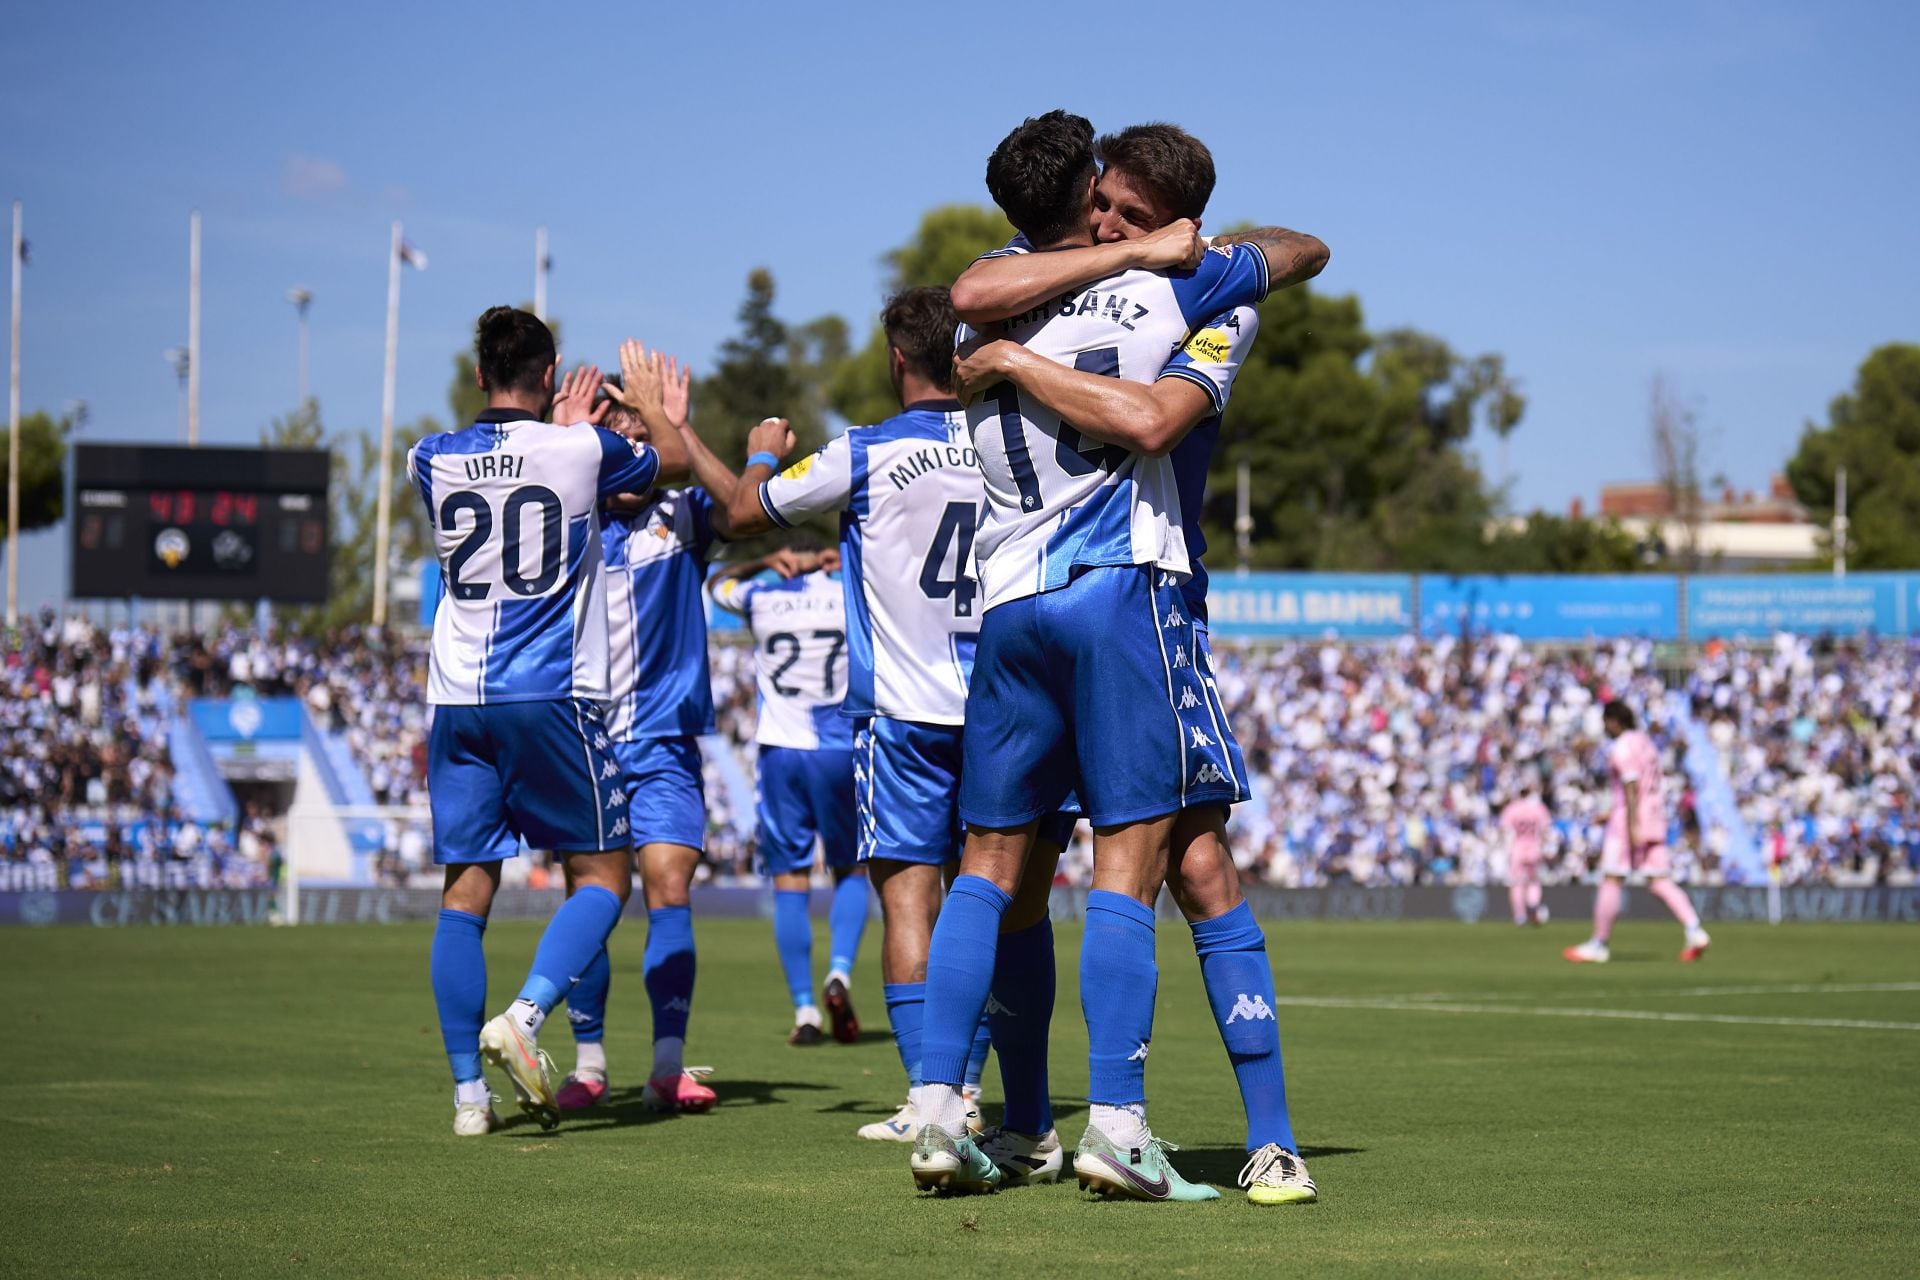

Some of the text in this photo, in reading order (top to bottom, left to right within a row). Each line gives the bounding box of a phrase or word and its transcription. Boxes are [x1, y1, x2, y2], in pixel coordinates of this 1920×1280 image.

[1058, 290, 1150, 332] SANZ
[1195, 338, 1225, 355] visit
[464, 454, 524, 481] URRI
[888, 447, 977, 491] MIKI CO
[440, 485, 563, 600] 20
[919, 501, 978, 617] 4
[766, 629, 846, 697] 27
